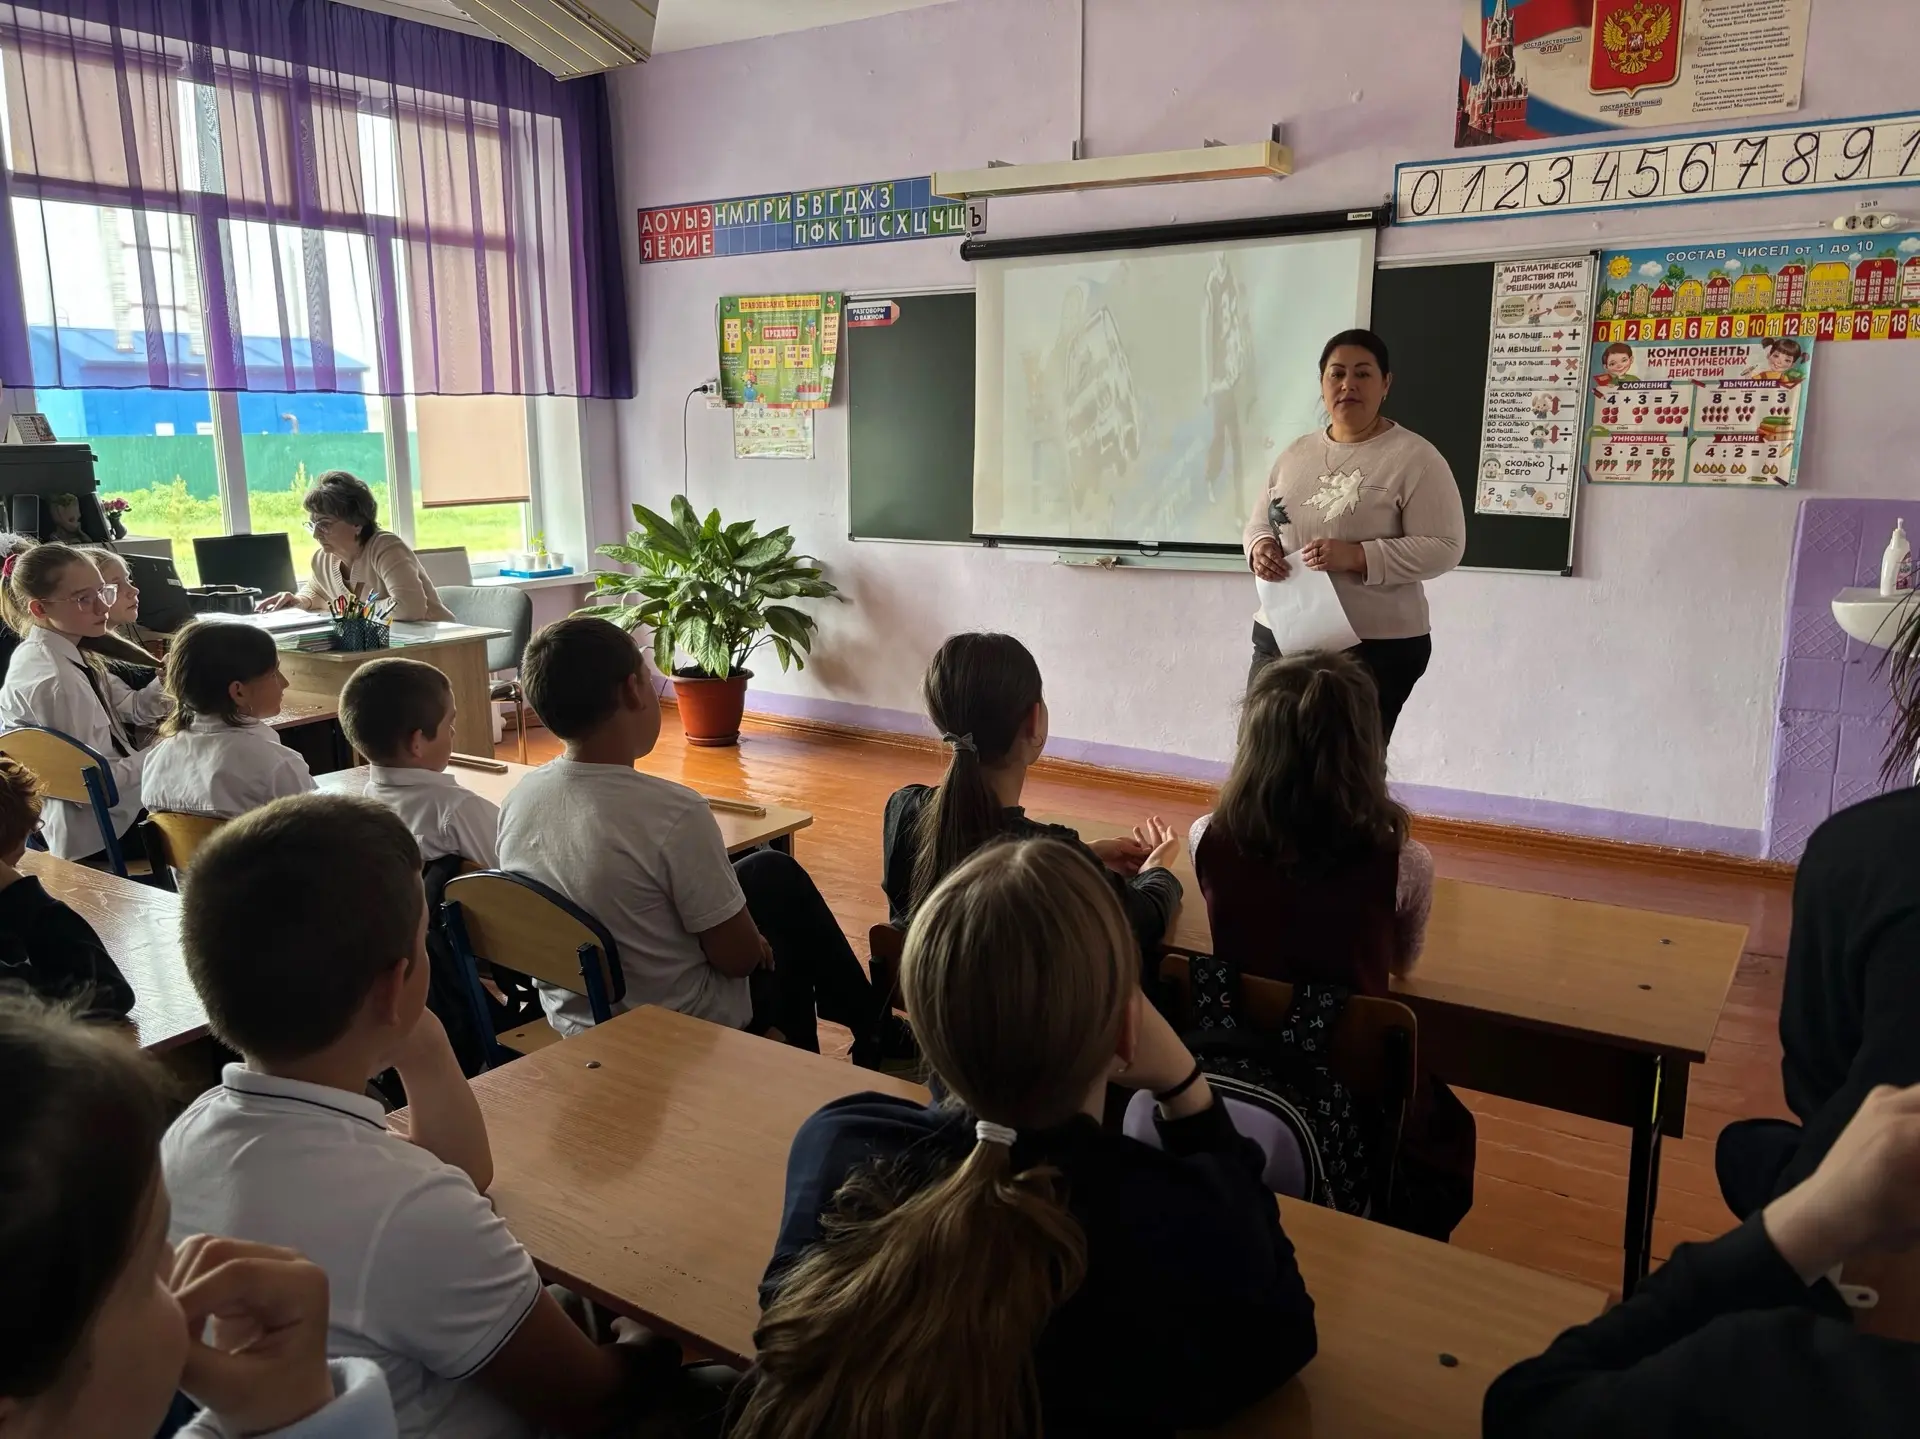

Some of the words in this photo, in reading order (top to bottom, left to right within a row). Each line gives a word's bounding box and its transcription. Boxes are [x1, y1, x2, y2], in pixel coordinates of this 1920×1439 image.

[1540, 44, 1564, 53] ФЛАГ
[1618, 107, 1641, 117] ГЕРБ
[1411, 170, 1440, 216] 0
[1461, 165, 1487, 212] 1
[1493, 161, 1529, 210] 2
[1537, 156, 1572, 205] 3
[1592, 152, 1618, 201] 4
[1628, 147, 1668, 198] 5
[1679, 142, 1716, 193] 6
[1733, 136, 1768, 189] 7
[1782, 132, 1820, 185] 8
[1834, 127, 1874, 180] 9
[1666, 249, 1726, 262] СОСТАВ
[1737, 245, 1789, 258] ЧИСЕЛ
[1795, 246, 1812, 255] от
[1818, 244, 1824, 253] 1
[1830, 244, 1850, 254] до
[1857, 240, 1874, 251] 10
[1504, 261, 1582, 273] МАТЕМАТИЧЕСКИЕ
[1510, 272, 1554, 283] ДЕЙСТВИЯ
[1506, 283, 1546, 292] РЕШЕНИИ
[1548, 281, 1578, 290] ЗАДАЧ
[1598, 325, 1607, 341] 0
[1614, 325, 1621, 341] 1
[1627, 324, 1637, 341] 2
[1642, 323, 1652, 340] 3
[1657, 323, 1667, 340] 4
[1674, 322, 1683, 340] 5
[1689, 321, 1698, 339] 6
[1705, 320, 1714, 338] 7
[1720, 320, 1729, 337] 8
[1735, 319, 1745, 337] 9
[1750, 319, 1764, 336] 10
[1767, 318, 1780, 336] 11
[1784, 318, 1798, 335] 12
[1801, 317, 1816, 336] 13
[1819, 316, 1833, 334] 14
[1836, 315, 1851, 333] 15
[1854, 315, 1869, 333] 16
[1872, 315, 1888, 332] 17
[1892, 314, 1906, 332] 18
[1647, 346, 1750, 358] КОМПОНЕНТЫ
[1648, 356, 1747, 367] МАТЕМАТИЧЕСКИХ
[1667, 367, 1724, 378] ДЕЙСТВИЙ
[1723, 380, 1776, 388] ВЫЧИТАНИЕ
[1607, 395, 1616, 404] 4
[1638, 395, 1647, 404] 3
[1670, 394, 1678, 404] 7
[1713, 394, 1722, 403] 8
[1744, 393, 1752, 403] 5
[1777, 393, 1786, 403] 3
[1604, 446, 1612, 456] 3
[1630, 447, 1639, 456] 2
[1662, 447, 1670, 456] 6
[1705, 448, 1715, 457] 4
[1735, 448, 1743, 458] 2
[1768, 448, 1777, 458] 2
[1505, 460, 1545, 468] СКОЛЬКО
